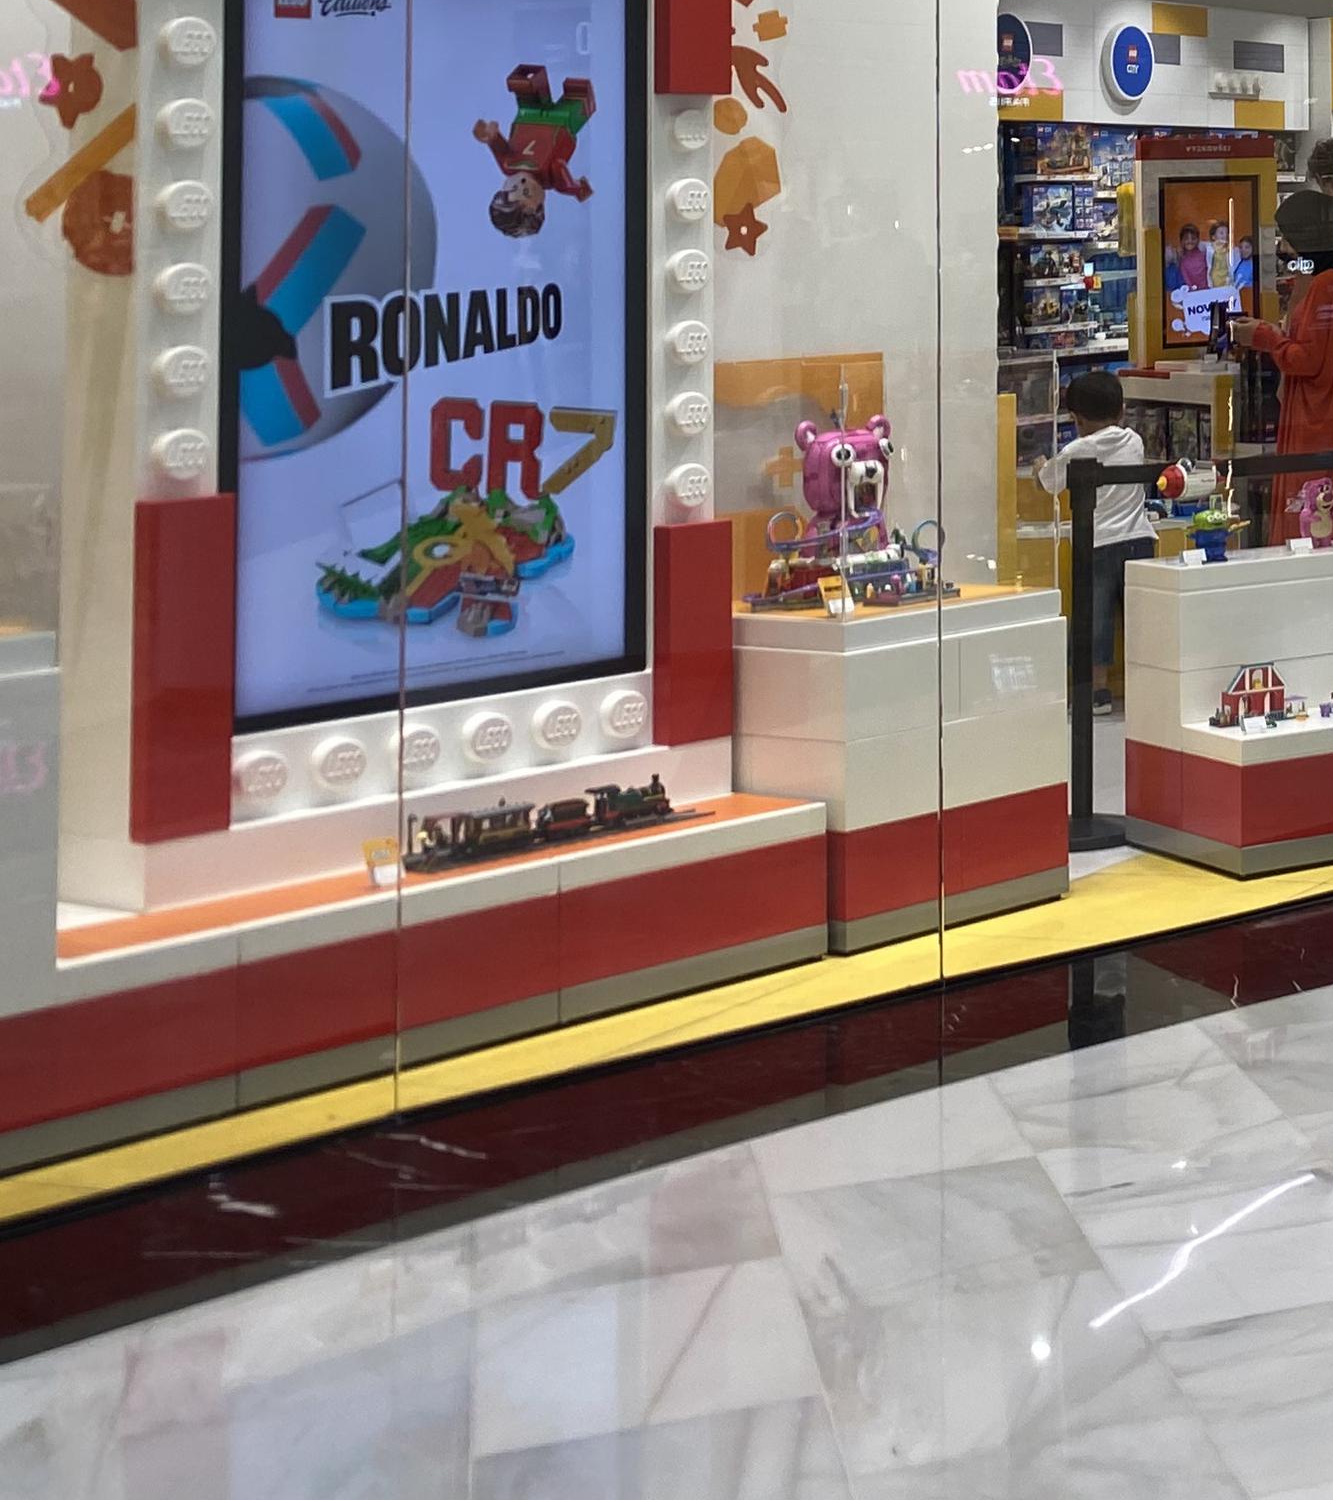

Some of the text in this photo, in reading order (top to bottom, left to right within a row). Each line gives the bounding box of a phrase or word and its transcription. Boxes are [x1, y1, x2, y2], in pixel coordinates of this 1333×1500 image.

[523, 140, 536, 156] 7
[331, 282, 562, 390] RONALDO
[430, 397, 618, 500] CR7
